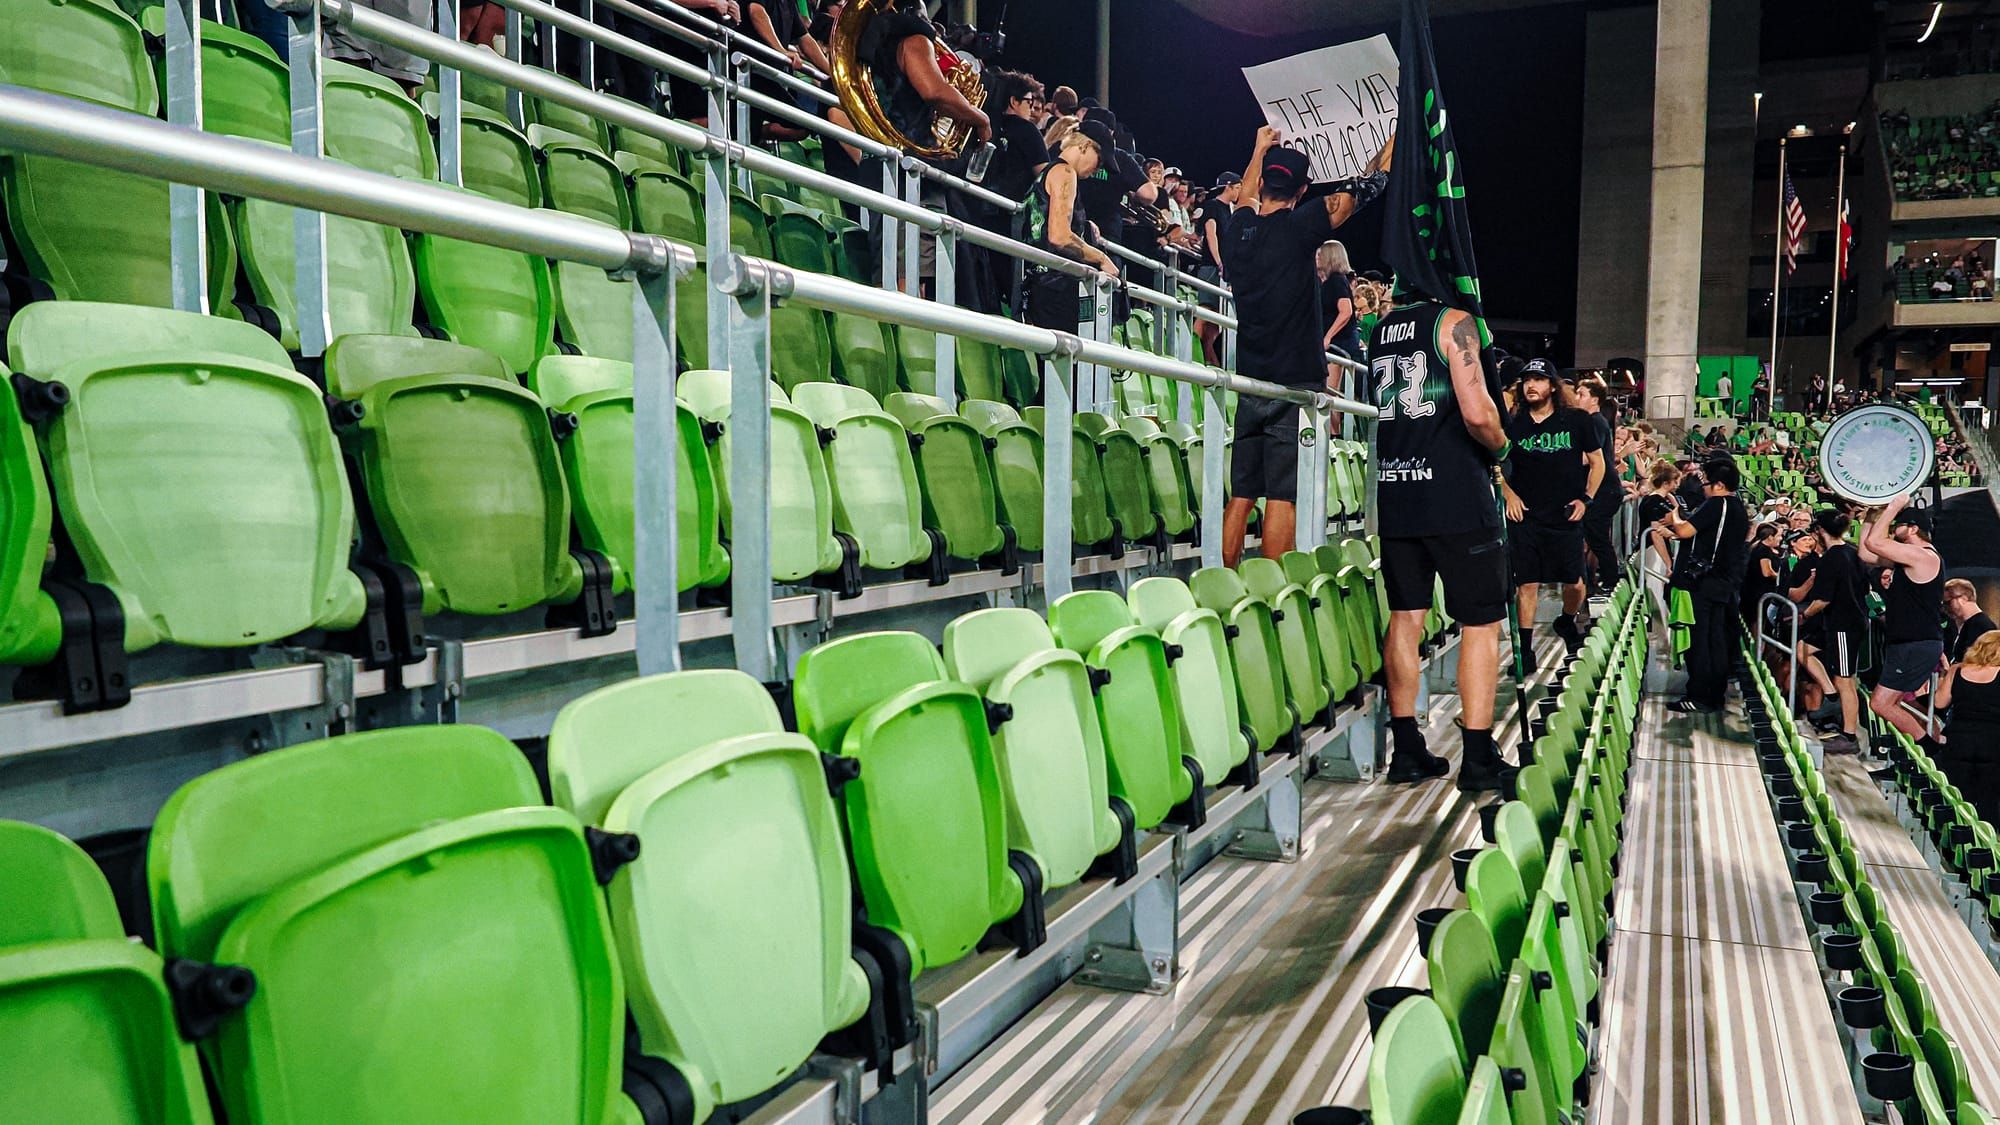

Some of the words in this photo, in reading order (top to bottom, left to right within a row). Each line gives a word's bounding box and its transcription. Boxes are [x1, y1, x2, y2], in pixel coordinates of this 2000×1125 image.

[1266, 88, 1336, 133] THE
[1380, 320, 1416, 345] LMDA
[1377, 467, 1433, 482] USTIN
[1839, 469, 1872, 492] AUSTIN
[1873, 484, 1885, 492] FC
